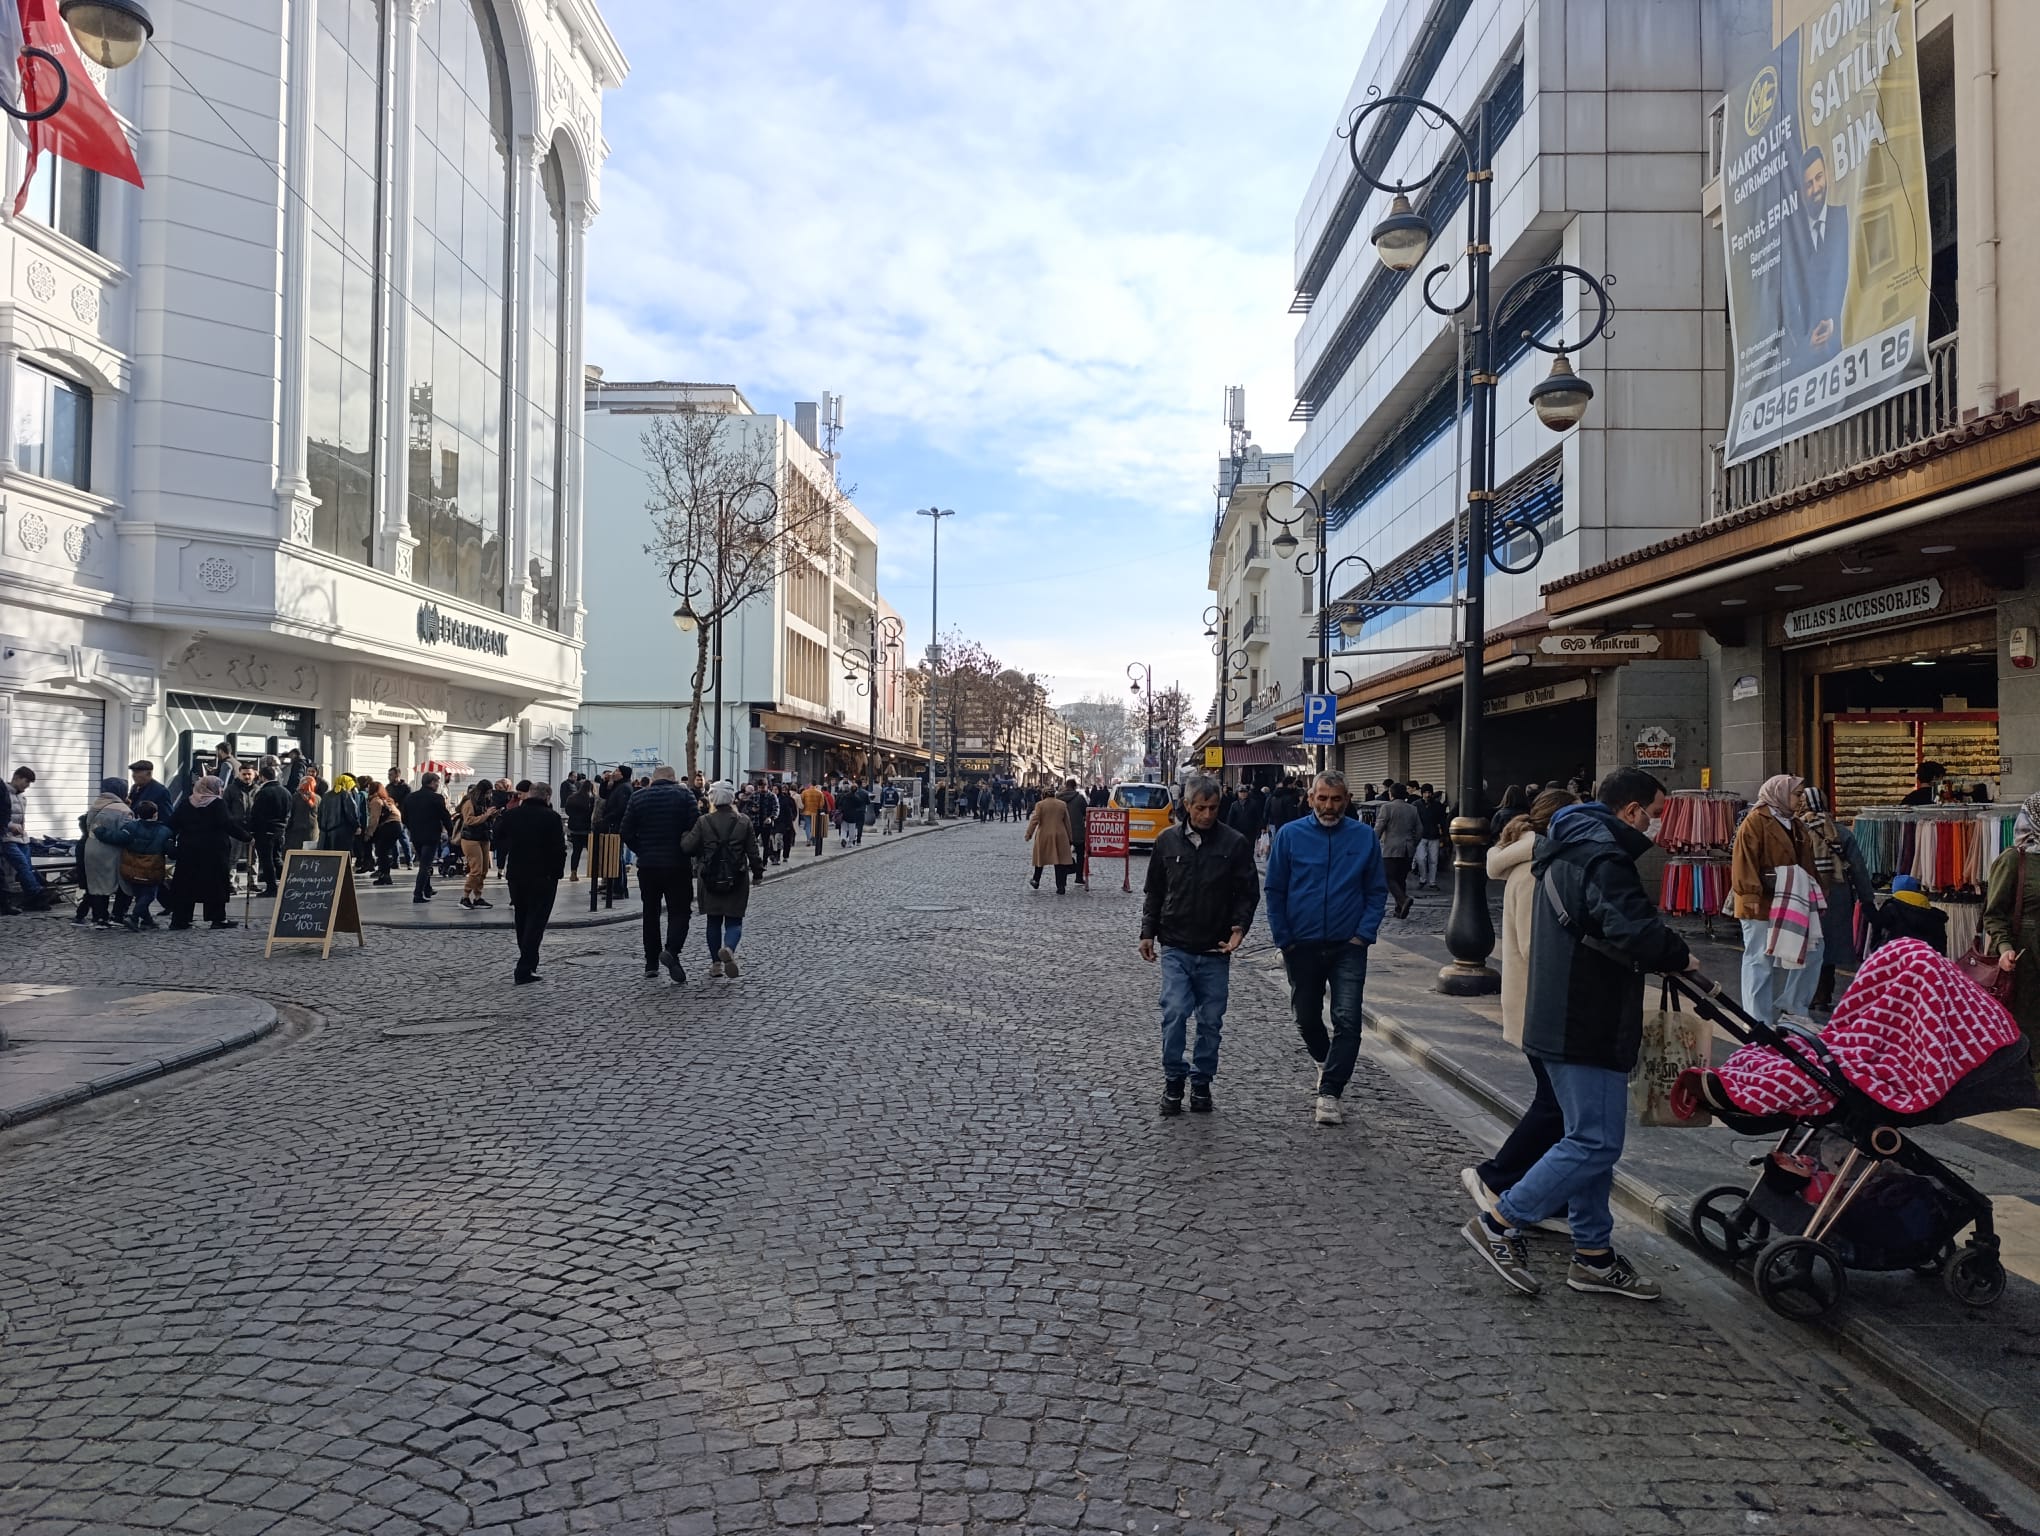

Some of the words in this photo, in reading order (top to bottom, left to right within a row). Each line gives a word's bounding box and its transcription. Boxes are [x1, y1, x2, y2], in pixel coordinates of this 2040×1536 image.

[1810, 10, 1902, 126] SATILIK
[1728, 137, 1767, 187] MAKRO
[1770, 114, 1791, 152] LIFE
[1832, 107, 1885, 181] BİNA
[1731, 219, 1766, 256] Ferhat
[1753, 386, 1799, 431] 0546
[1803, 365, 1840, 407] 216
[1843, 348, 1869, 387] 31
[1880, 329, 1909, 371] 26
[440, 615, 509, 658] HALKBANK
[1308, 697, 1327, 724] P
[1090, 822, 1125, 834] OTOPARK
[1093, 811, 1123, 821] ÇARŞI
